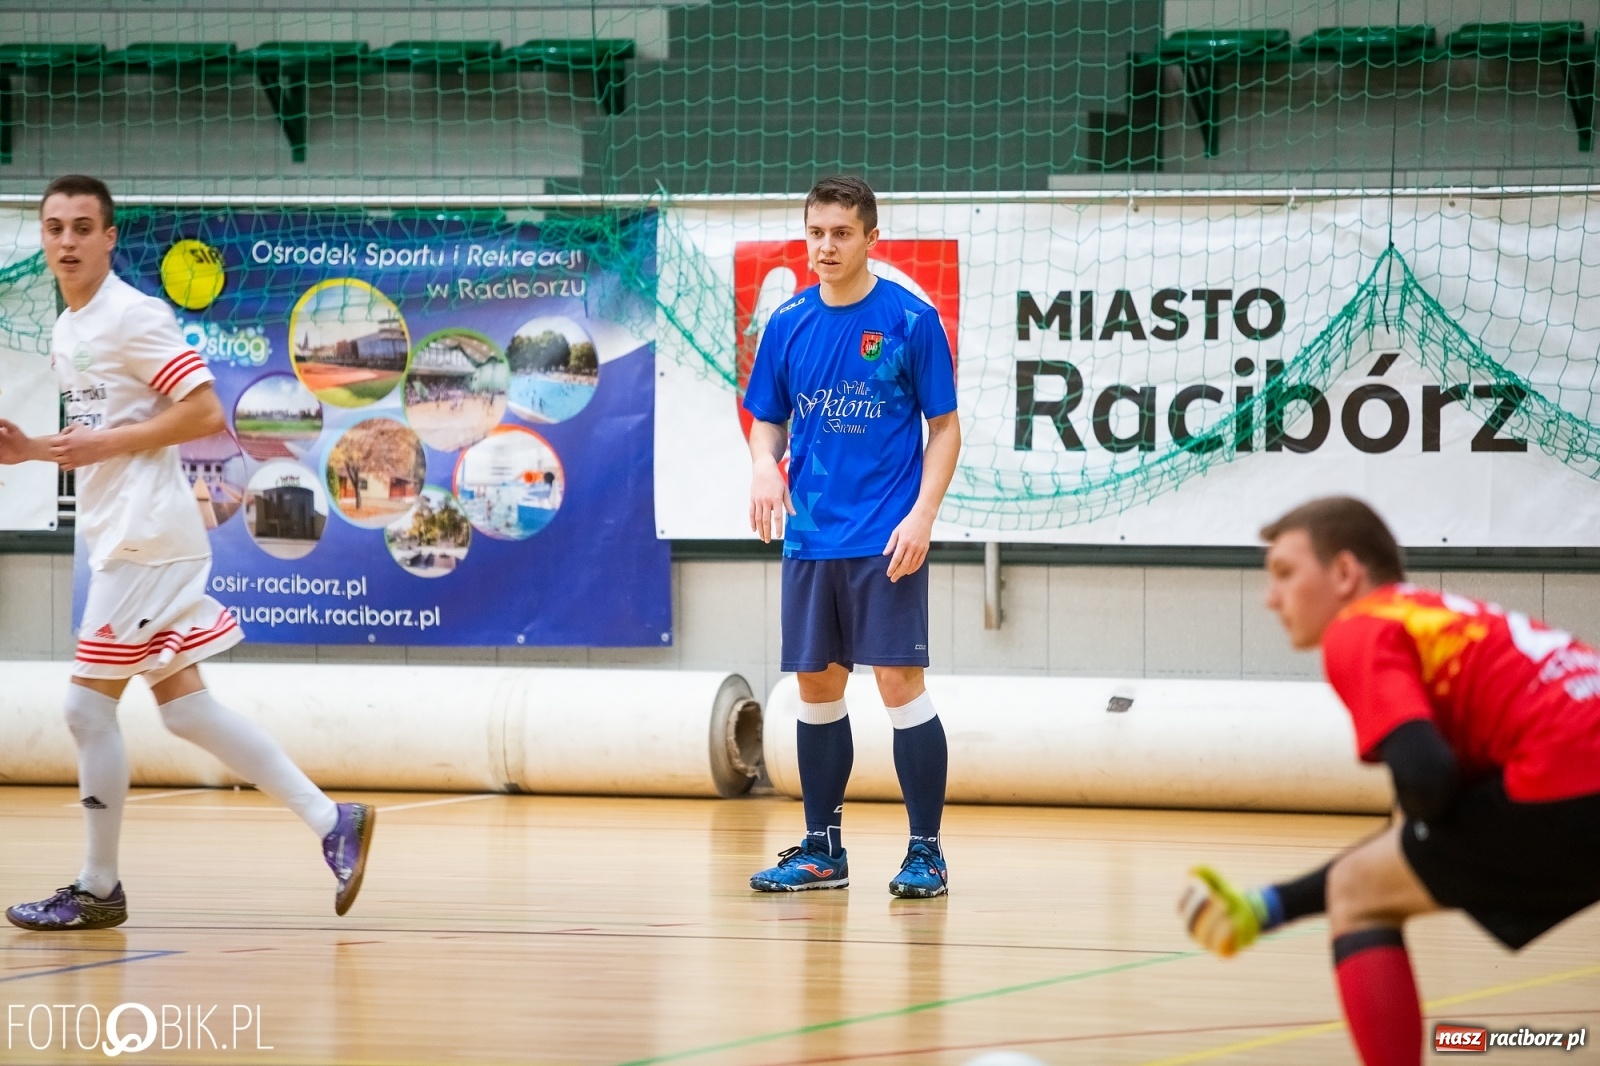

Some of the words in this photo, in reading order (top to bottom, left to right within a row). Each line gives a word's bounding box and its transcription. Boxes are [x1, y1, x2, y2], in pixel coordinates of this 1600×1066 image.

[251, 240, 357, 265] Ośrodek
[364, 242, 444, 269] Sportu
[452, 246, 459, 266] i
[466, 244, 584, 269] Rekreacji
[427, 283, 449, 300] w
[458, 277, 586, 300] Raciborzu
[1016, 288, 1286, 341] MIASTO
[182, 323, 268, 363] Ostróg
[1013, 352, 1528, 454] Racibórz
[227, 603, 441, 632] quapark.raciborz.pl
